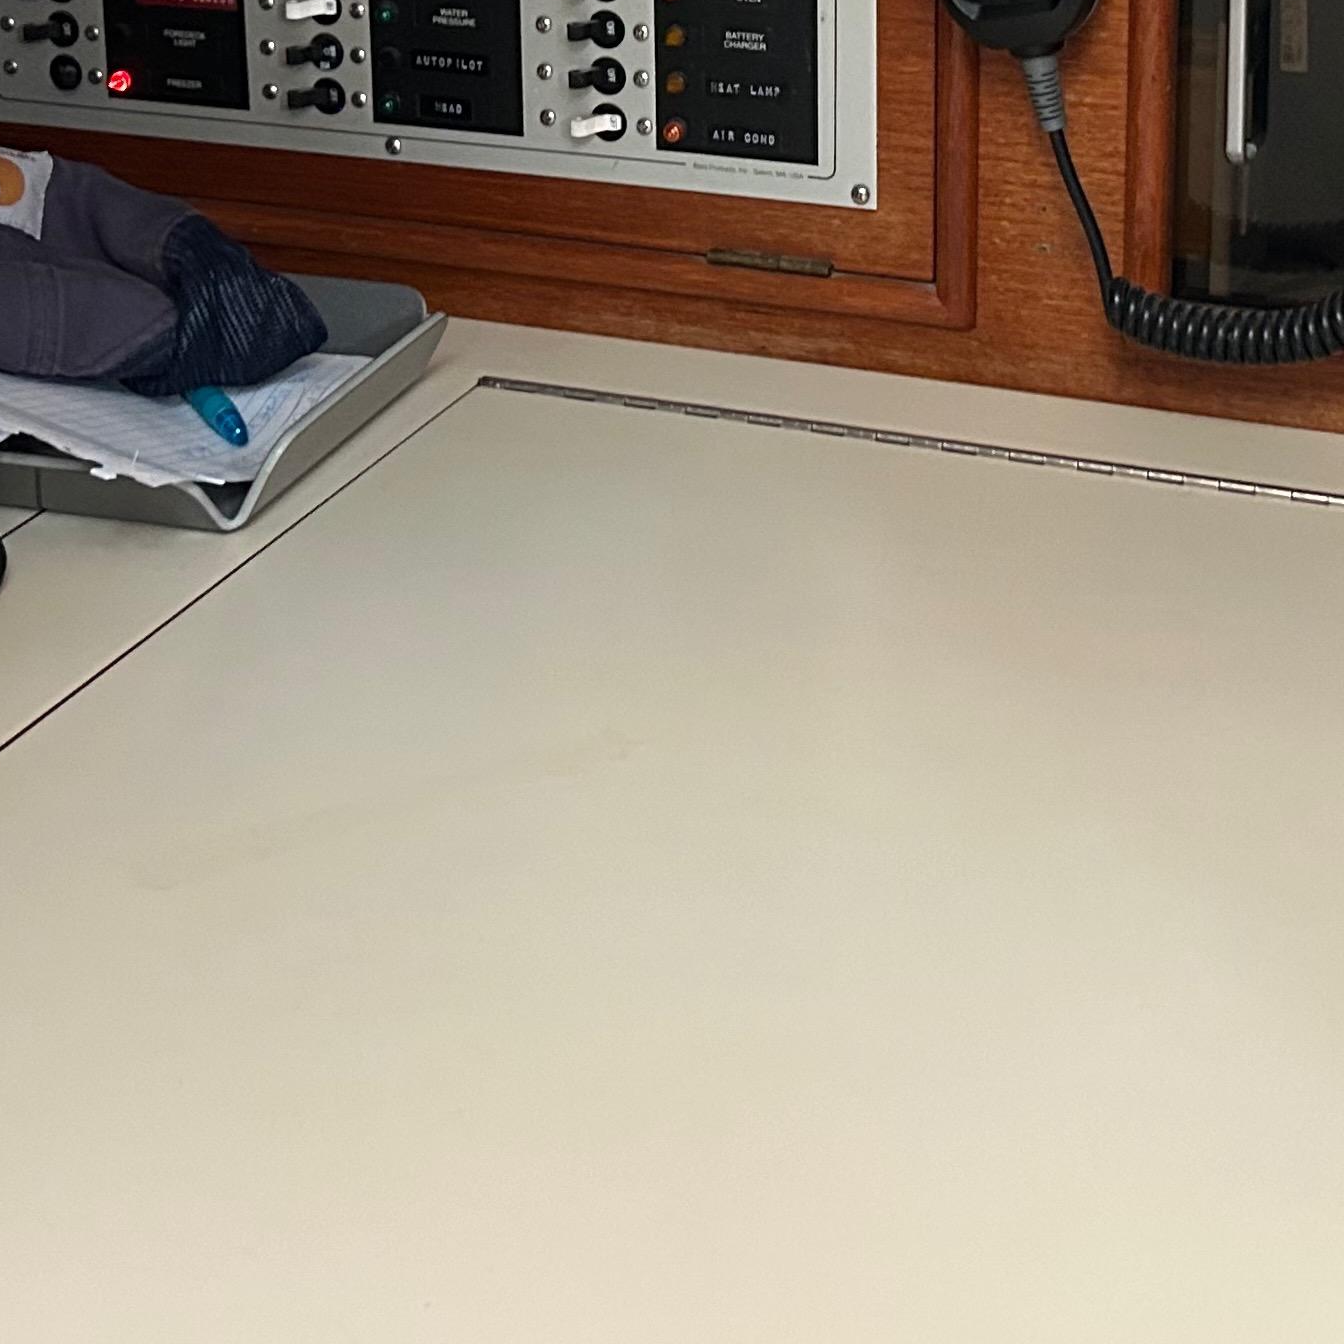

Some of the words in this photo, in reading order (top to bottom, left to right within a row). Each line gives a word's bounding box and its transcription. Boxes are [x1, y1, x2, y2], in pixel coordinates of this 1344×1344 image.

[725, 31, 765, 43] BATTERY
[723, 40, 767, 52] CHARGER
[416, 56, 483, 71] AUTOPILOT
[710, 82, 740, 95] HEAT
[750, 83, 781, 98] LAMP
[712, 130, 735, 142] AIR
[744, 132, 776, 146] COND
